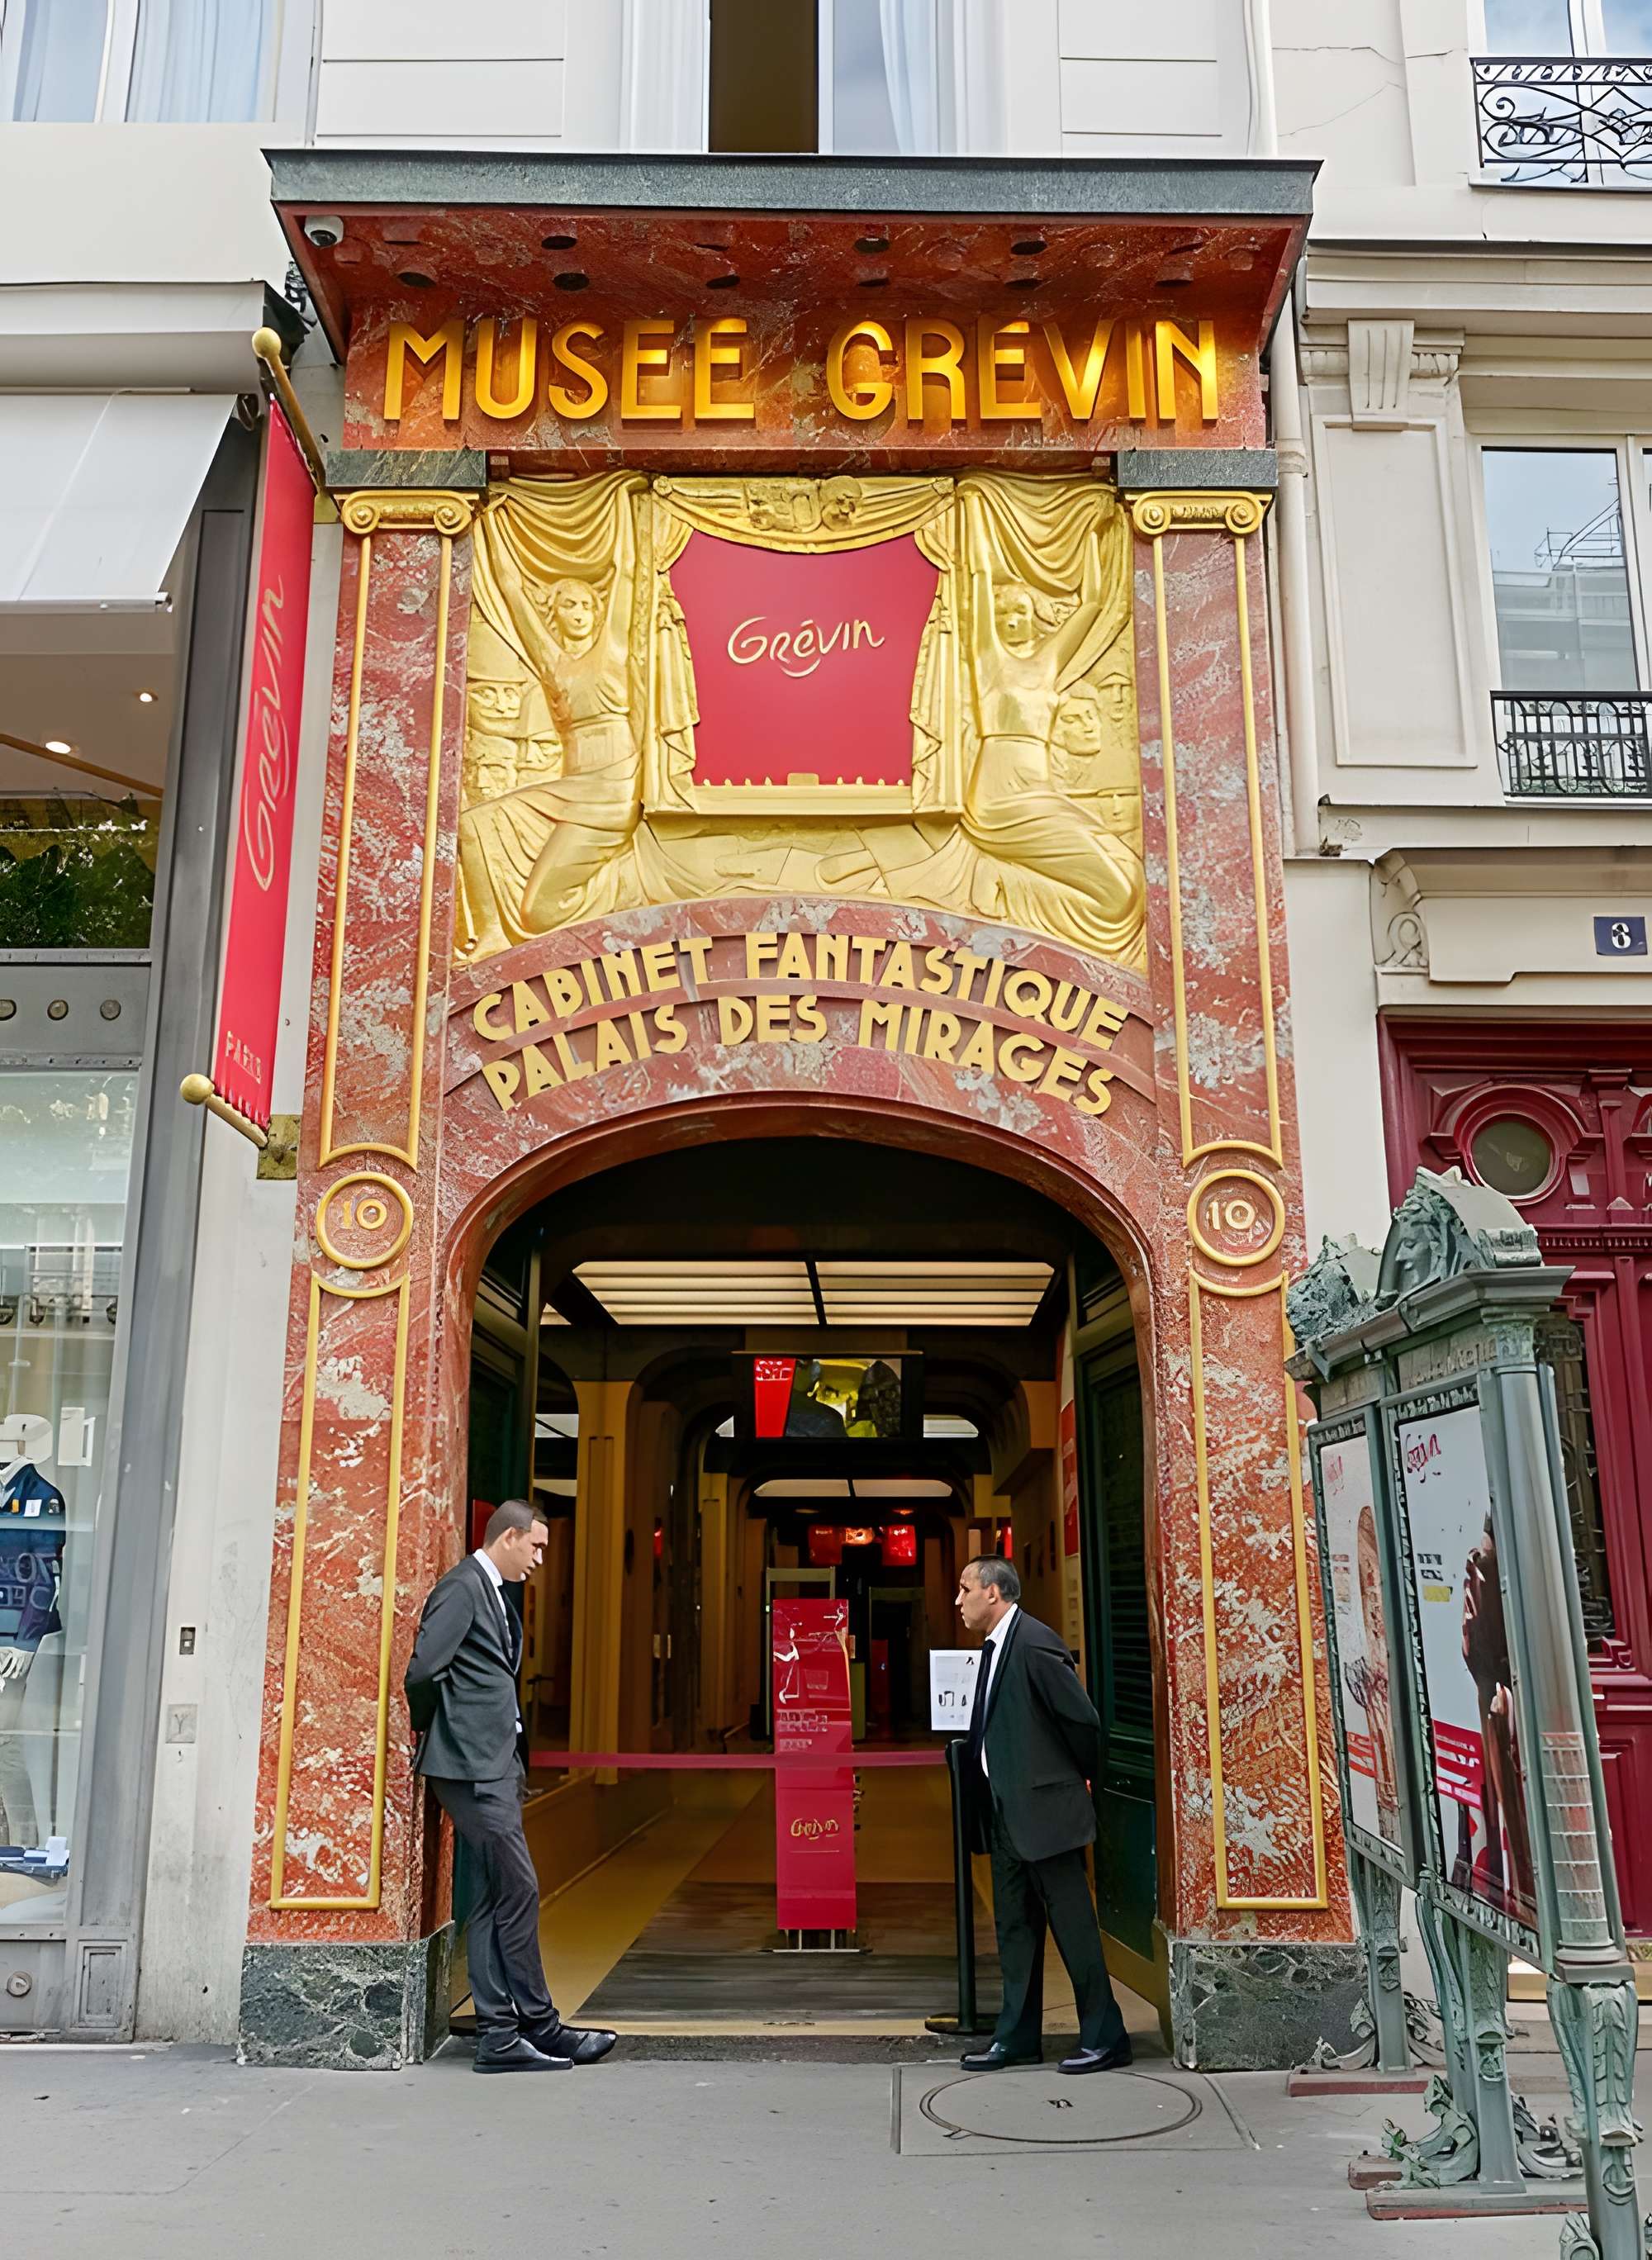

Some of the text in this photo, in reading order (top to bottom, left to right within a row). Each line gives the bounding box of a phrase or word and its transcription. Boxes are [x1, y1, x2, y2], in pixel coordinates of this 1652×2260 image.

[473, 932, 1130, 1051] CABINET FANTASTIQUE
[482, 995, 1118, 1116] PALAIS DES MIRAGES
[343, 1199, 387, 1230] 10
[1212, 1199, 1256, 1230] 10
